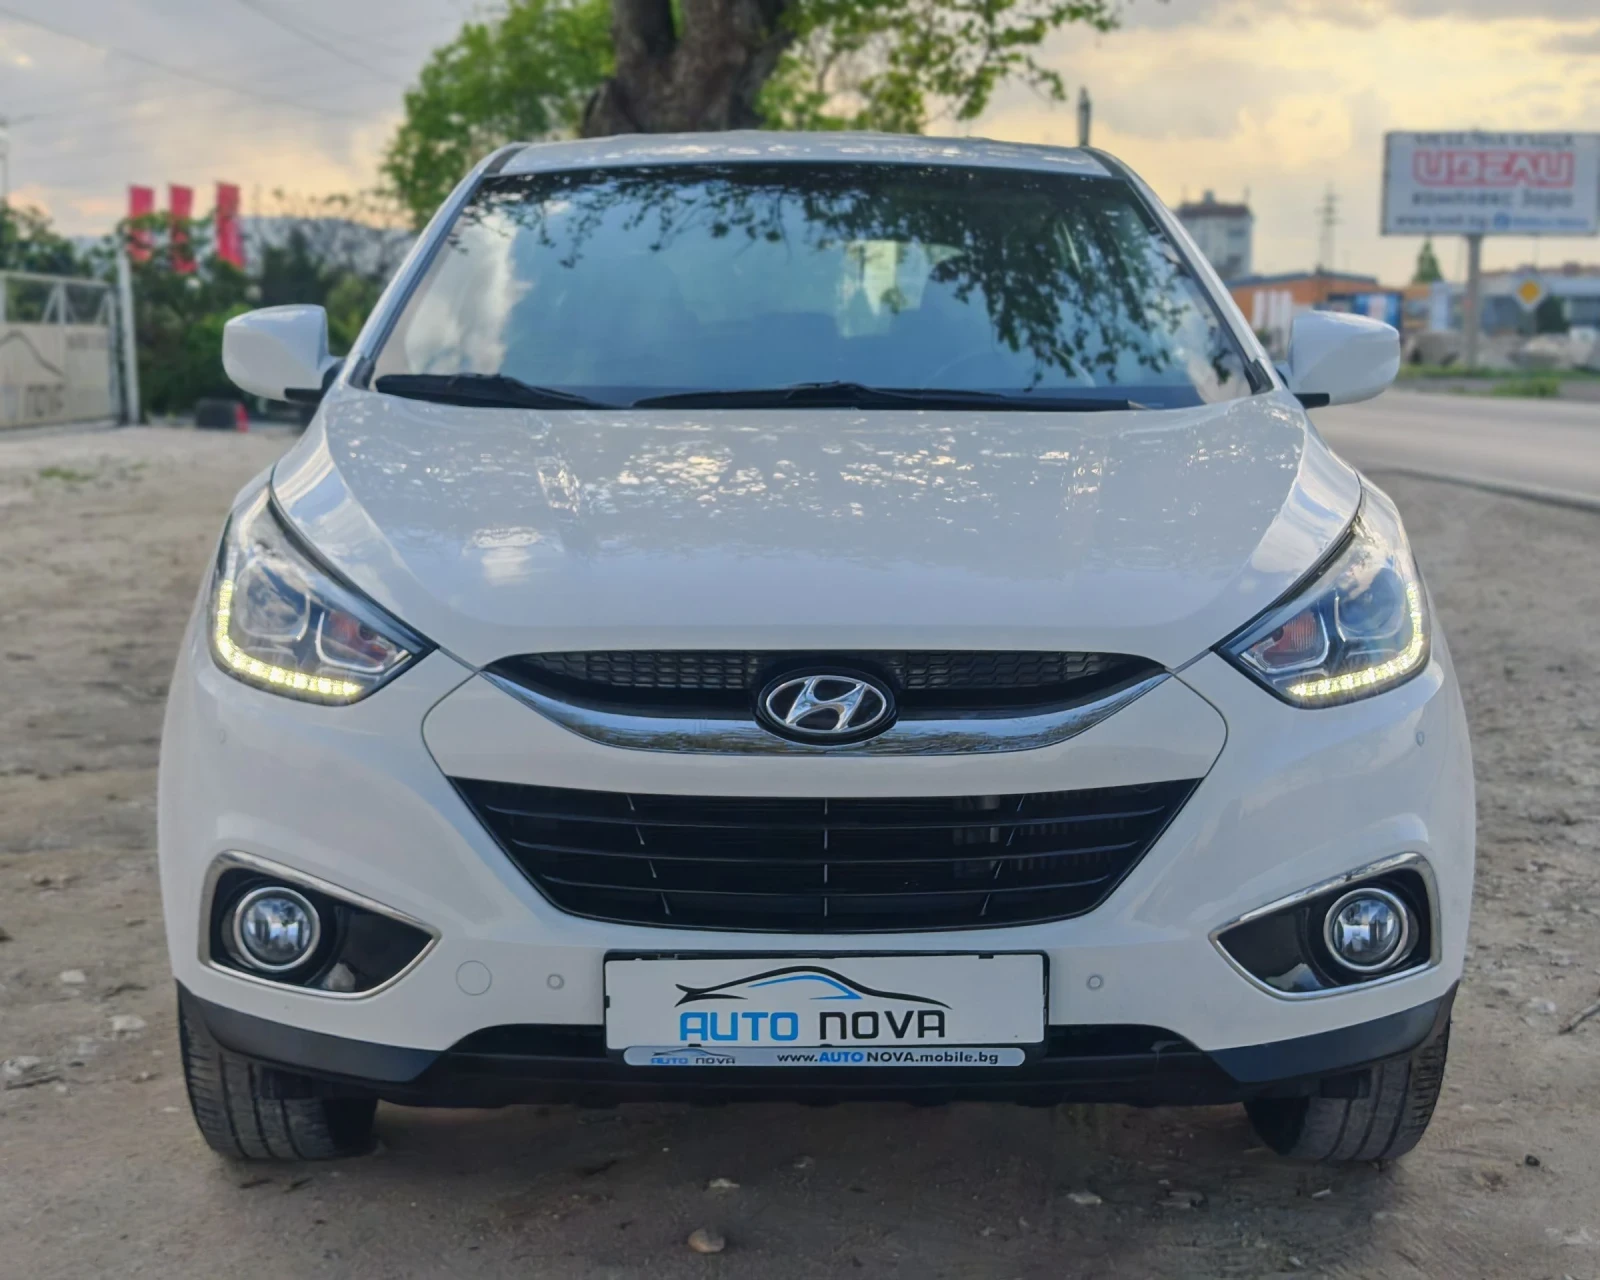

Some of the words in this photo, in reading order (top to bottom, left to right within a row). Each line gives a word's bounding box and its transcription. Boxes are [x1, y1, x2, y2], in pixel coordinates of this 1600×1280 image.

[680, 1011, 799, 1041] AUTO
[819, 1010, 945, 1040] NOVA
[651, 1057, 689, 1065] AUTO
[695, 1057, 736, 1065] NOVA
